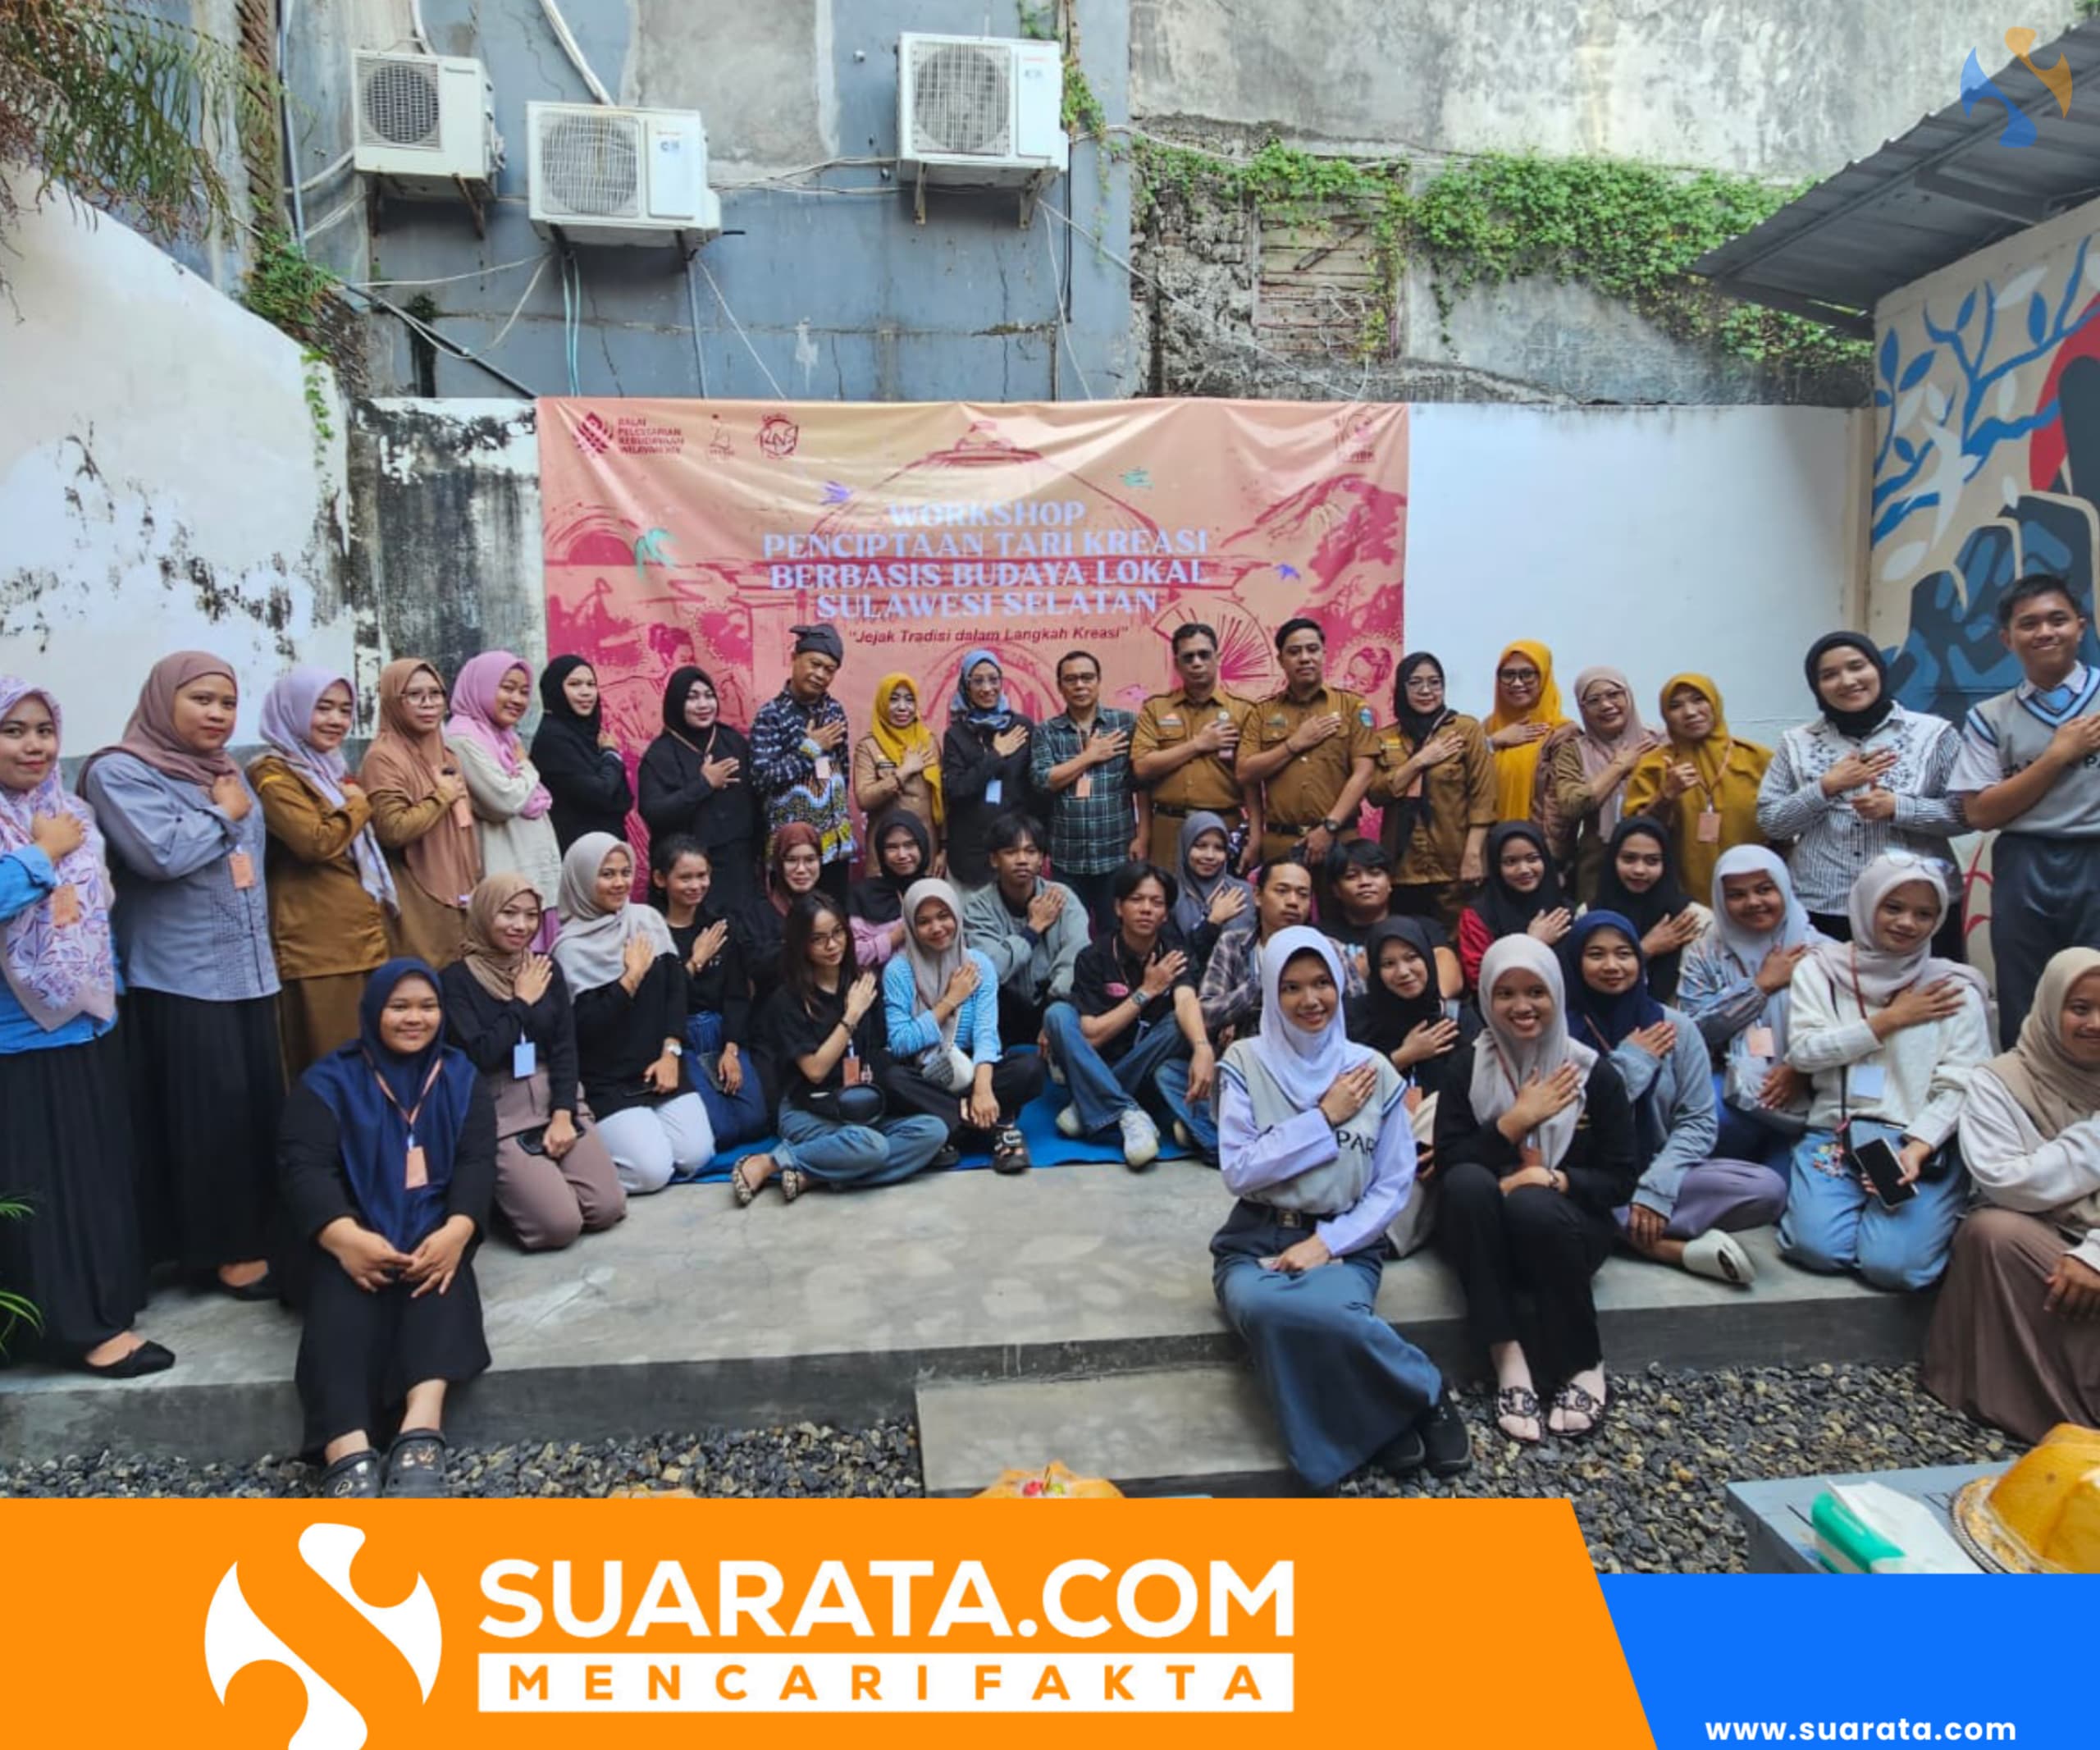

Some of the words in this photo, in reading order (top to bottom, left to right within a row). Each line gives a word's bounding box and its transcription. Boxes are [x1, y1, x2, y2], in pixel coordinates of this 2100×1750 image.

[890, 500, 1085, 526] WORKSHOP
[763, 532, 984, 559] PENCIPTAAN
[996, 531, 1073, 557] TARI
[1084, 528, 1208, 556] KREASI
[771, 562, 941, 589] BERBASIS
[953, 560, 1085, 587] BUDAYA
[1098, 559, 1210, 584] LOKAL
[817, 592, 993, 619] SULAWESI
[1003, 588, 1158, 616] SELATAN
[849, 630, 895, 646] "Jejak
[902, 629, 952, 642] Tradisi
[955, 628, 1000, 642] dalam
[1005, 627, 1067, 643] Langkah
[1073, 626, 1129, 640] Kreasi"
